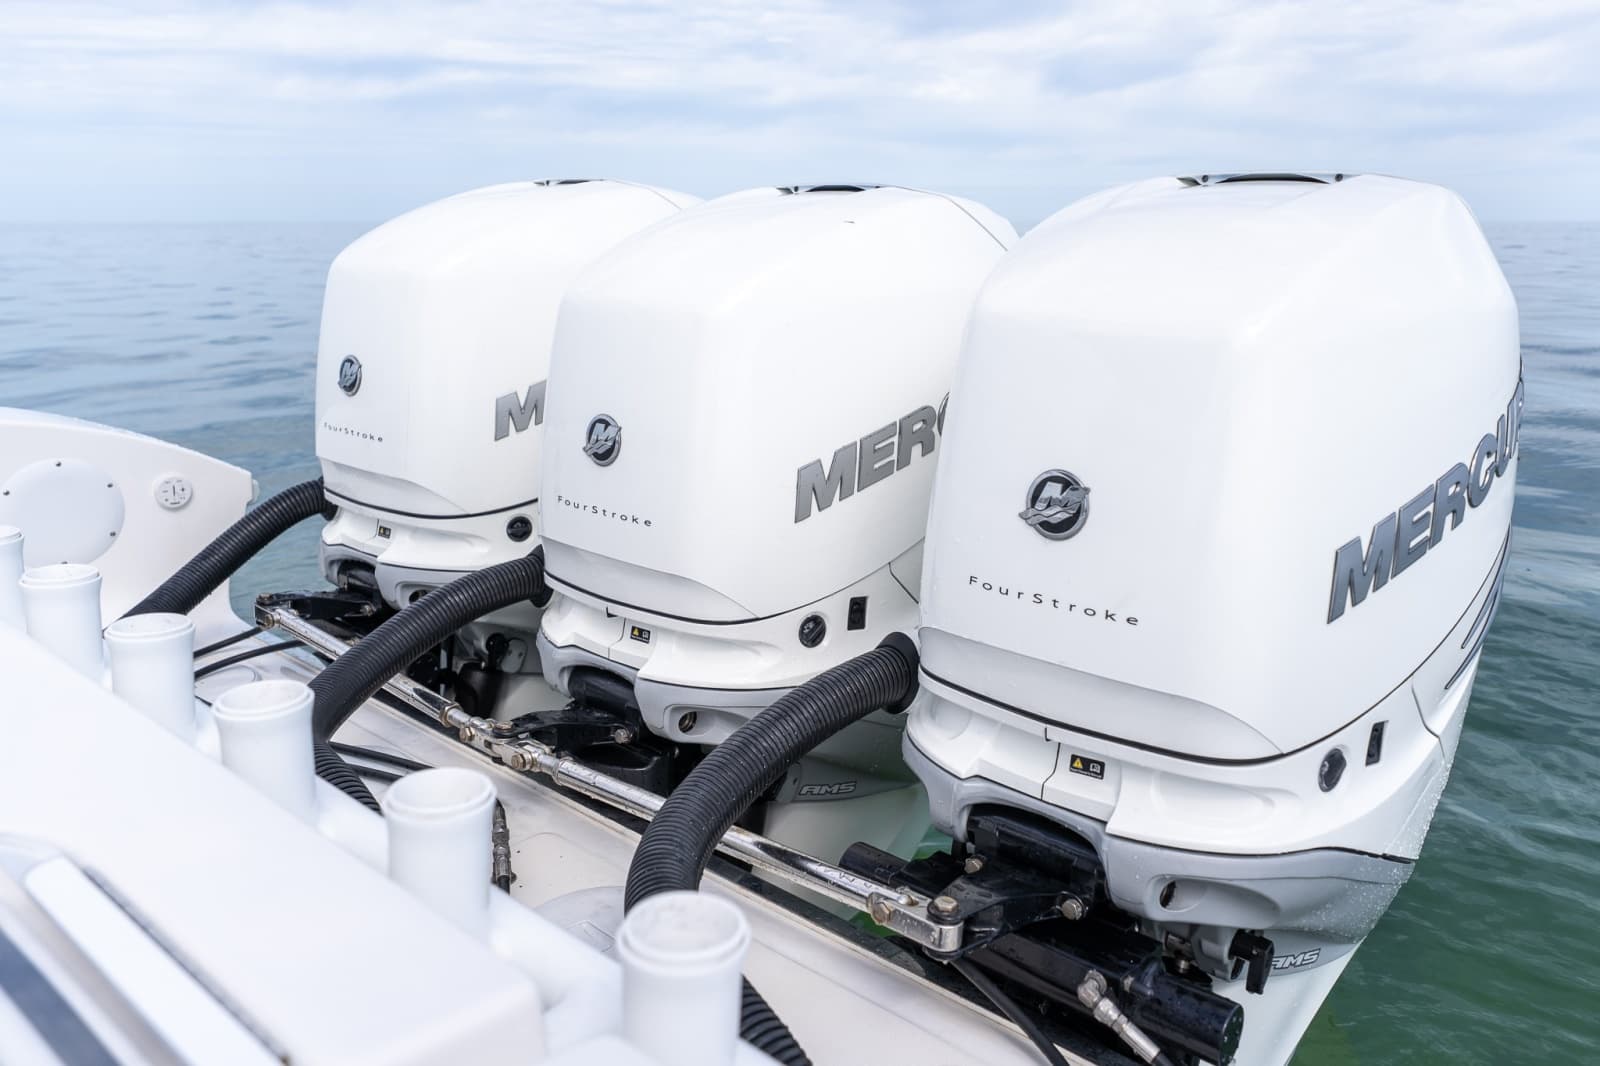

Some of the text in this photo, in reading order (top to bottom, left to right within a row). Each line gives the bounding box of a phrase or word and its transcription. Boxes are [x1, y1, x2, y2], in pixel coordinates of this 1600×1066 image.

[795, 391, 950, 523] MER
[557, 495, 653, 527] FourStroke
[968, 575, 1139, 626] FourStroke
[799, 780, 857, 796] AMS
